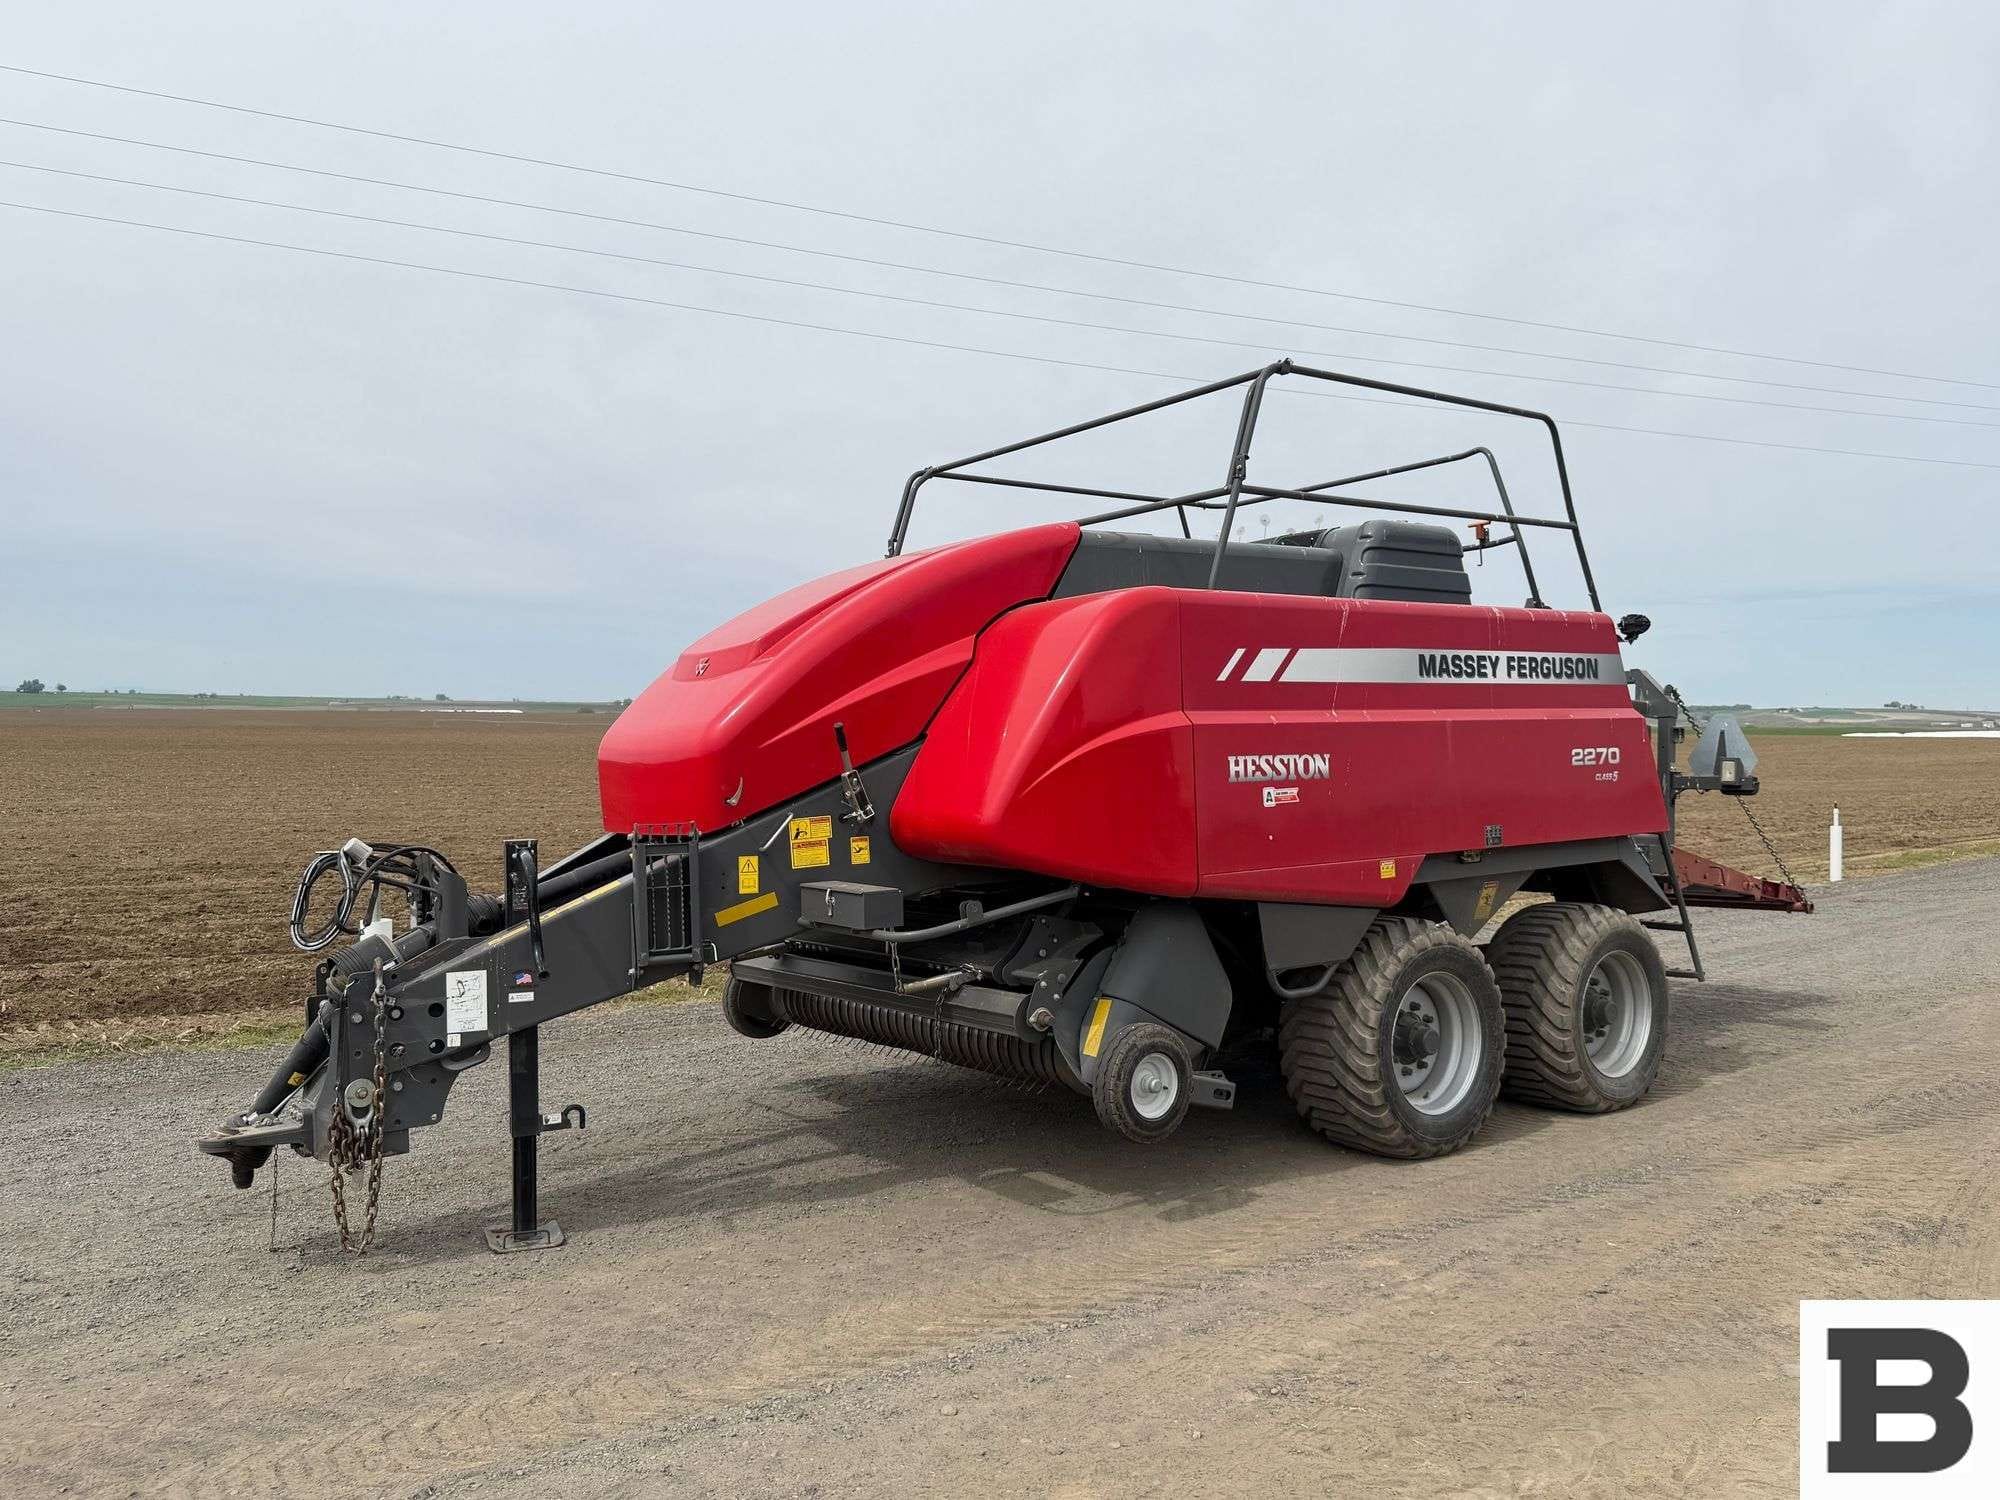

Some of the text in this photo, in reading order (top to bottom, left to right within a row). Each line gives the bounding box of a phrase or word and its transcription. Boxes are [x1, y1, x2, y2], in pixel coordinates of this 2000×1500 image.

[1418, 653, 1599, 680] MASSEY FERGUSON
[1228, 753, 1330, 783] HESSTON
[1571, 747, 1620, 766] 2270
